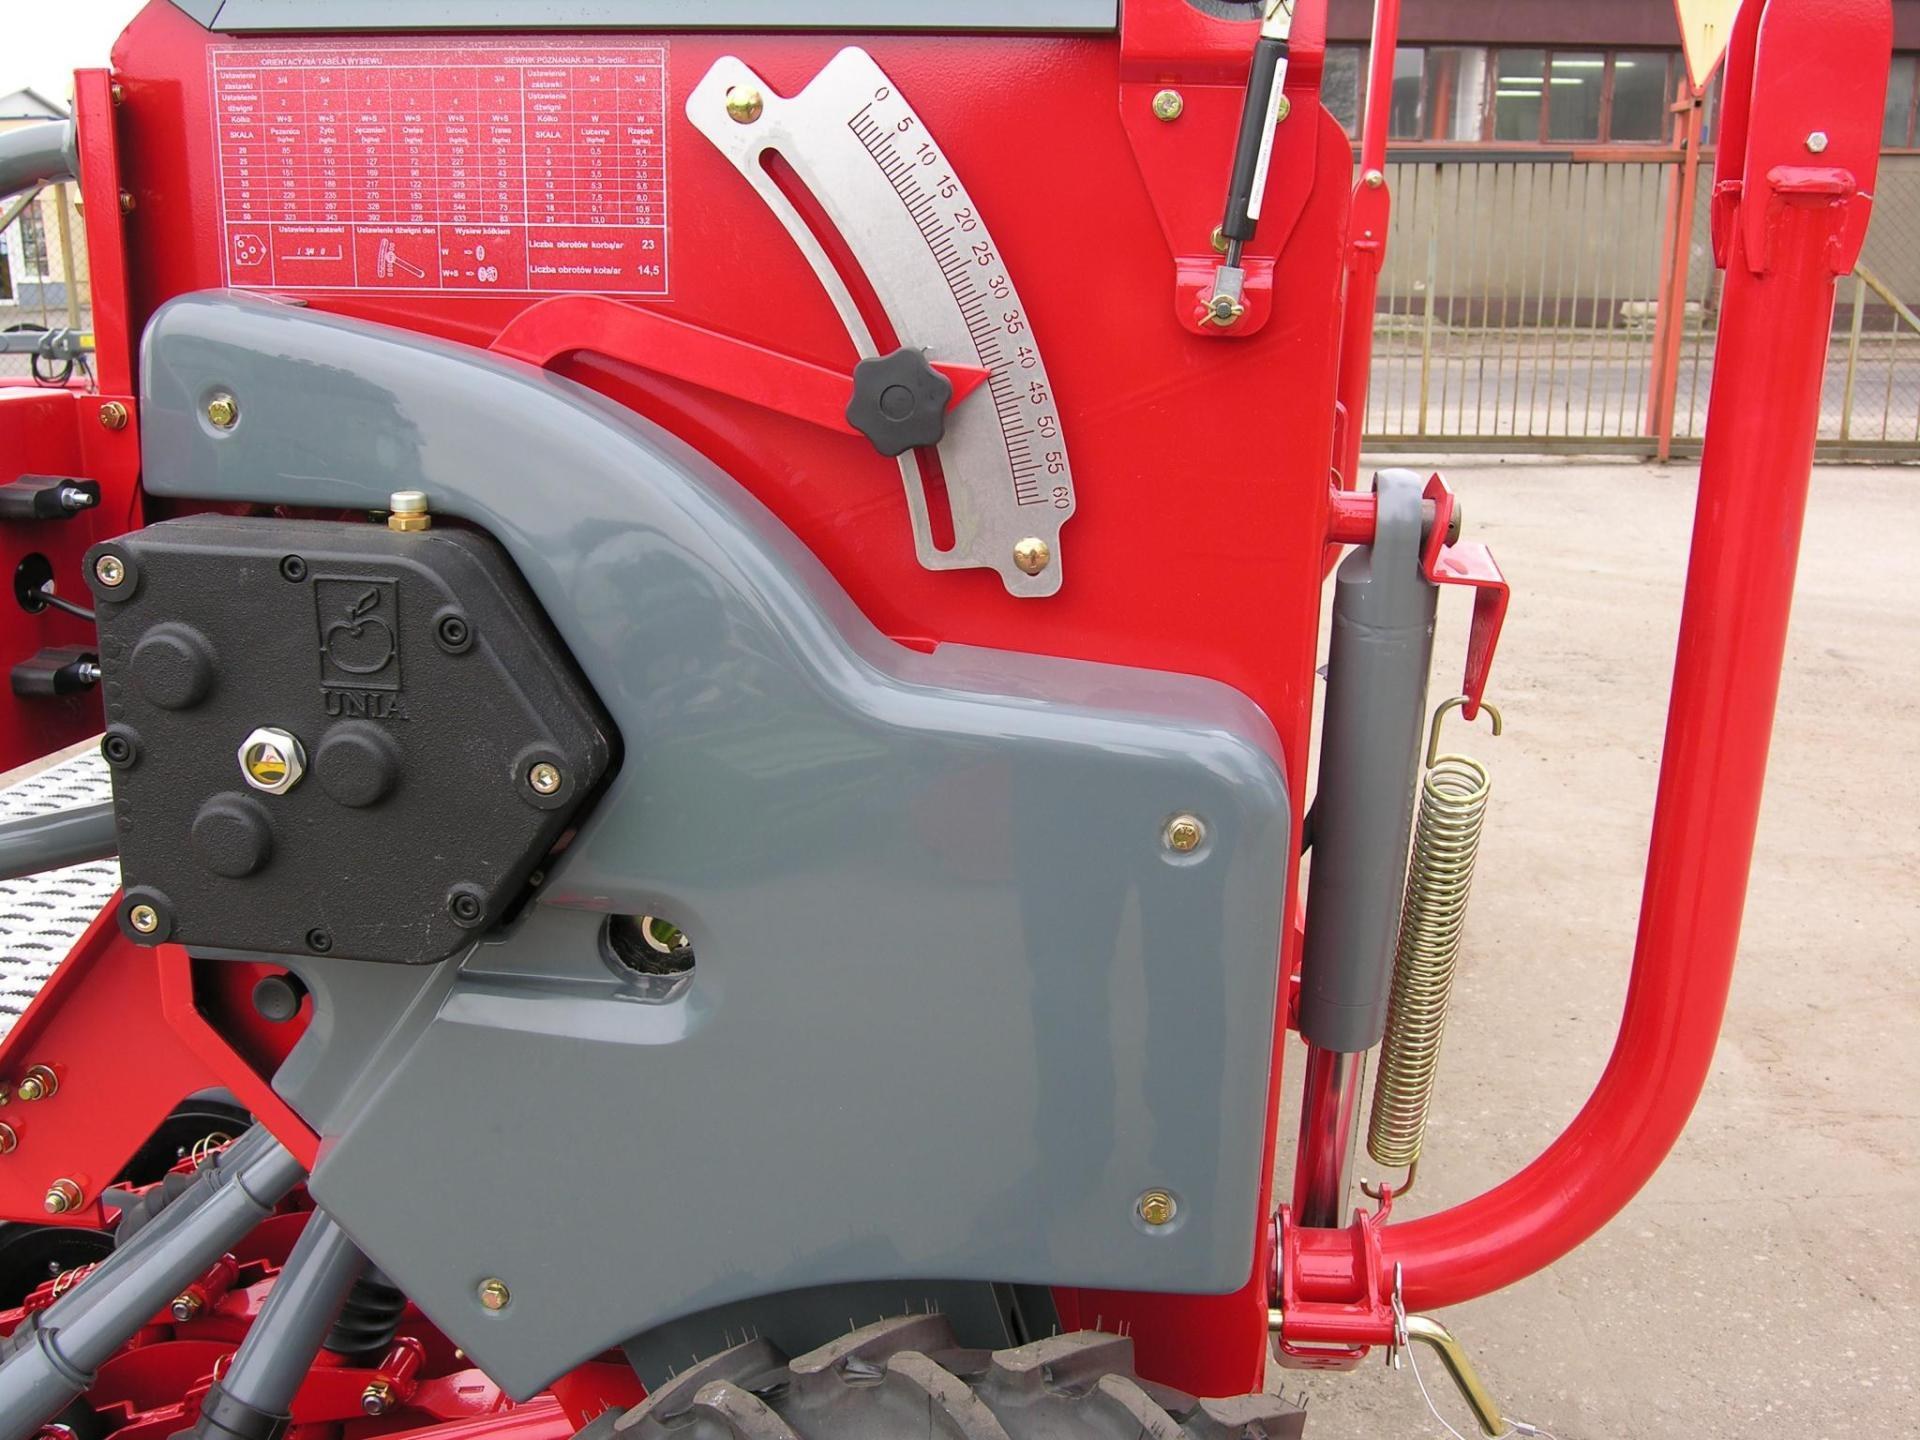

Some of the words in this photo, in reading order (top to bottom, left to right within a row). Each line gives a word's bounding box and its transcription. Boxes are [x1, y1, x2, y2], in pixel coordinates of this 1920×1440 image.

[317, 57, 347, 66] TABELA
[346, 57, 383, 65] WYSIEWU
[536, 56, 581, 64] POZNANIAK
[874, 86, 890, 102] 0
[590, 115, 600, 123] W
[636, 115, 645, 123] W
[897, 116, 914, 133] 5
[445, 126, 468, 134] Groch
[580, 127, 610, 136] Lucerna
[229, 131, 254, 139] SKALA
[535, 131, 562, 139] SKALA
[497, 147, 506, 155] 24
[915, 142, 937, 166] 10
[451, 158, 464, 166] 227
[366, 180, 379, 188] 217
[545, 181, 554, 189] 12
[936, 174, 958, 199] 15
[367, 191, 380, 199] 270
[953, 207, 977, 233] 20
[279, 225, 315, 233] Ustawienie
[316, 225, 345, 233] zastawki
[356, 226, 394, 234] Ustawienie
[422, 226, 436, 234] den
[454, 227, 482, 236] Wysiew
[528, 240, 554, 248] Liczba
[556, 240, 589, 249] obrotów
[641, 239, 655, 250] 23
[441, 248, 449, 256] W
[971, 240, 996, 266] 25
[442, 269, 459, 277] W+S
[529, 265, 557, 274] Liczba
[557, 265, 592, 274] obrotów
[637, 265, 660, 276] 14,5
[988, 274, 1010, 300] 30
[1002, 309, 1024, 335] 35
[1016, 346, 1037, 369] 40
[1029, 381, 1048, 405] 45
[1037, 415, 1057, 439] 50
[1045, 451, 1065, 474] 55
[1052, 486, 1070, 509] 60
[319, 687, 411, 720] UNIA
